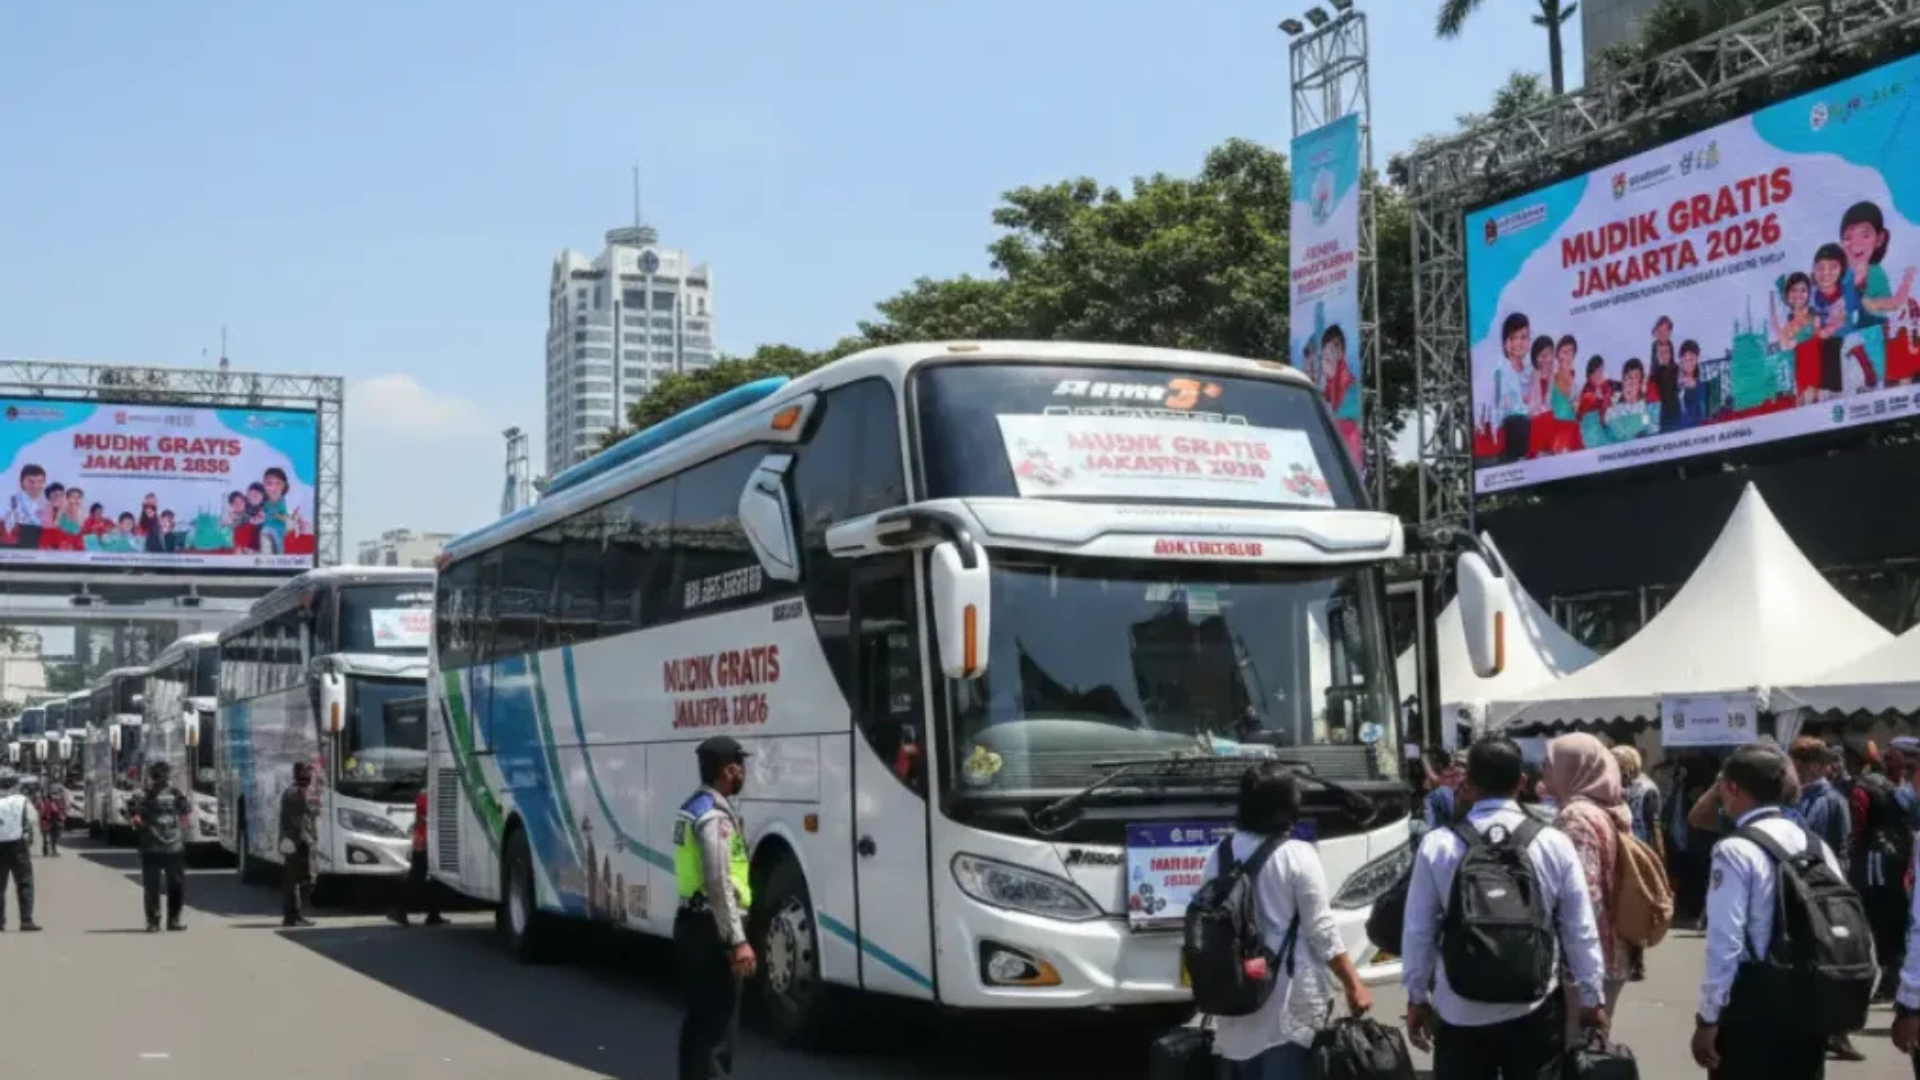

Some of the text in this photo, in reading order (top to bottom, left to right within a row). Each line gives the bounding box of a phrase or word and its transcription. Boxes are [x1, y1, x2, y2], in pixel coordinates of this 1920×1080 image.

[1562, 209, 1660, 268] MUDIK
[1667, 167, 1793, 234] GRATIS
[1572, 240, 1698, 298] JAKARTA
[1706, 213, 1781, 261] 2026
[717, 645, 780, 688] GRATIS
